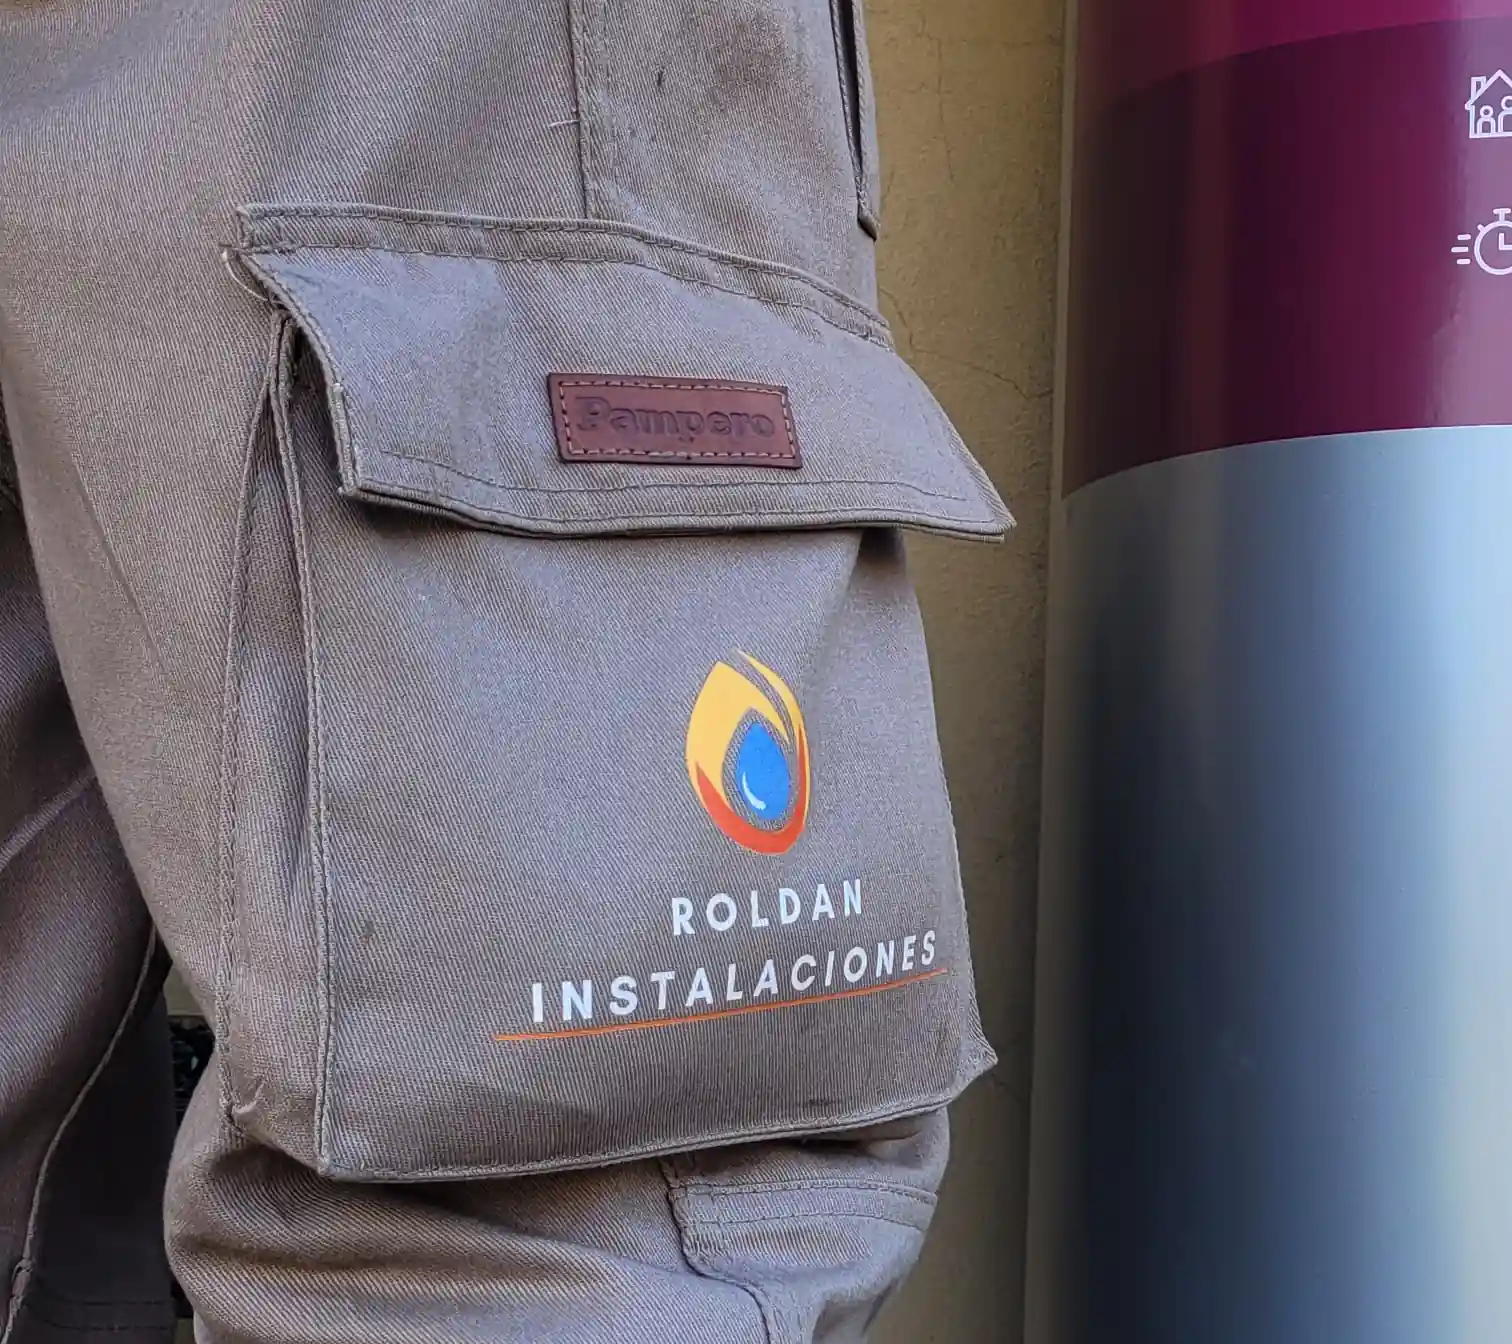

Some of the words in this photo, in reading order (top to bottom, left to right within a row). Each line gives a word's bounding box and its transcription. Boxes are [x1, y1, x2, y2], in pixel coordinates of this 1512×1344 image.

[575, 396, 775, 444] Pampero
[671, 877, 864, 937] ROLDAN
[530, 928, 939, 1024] INSTALACIONES
